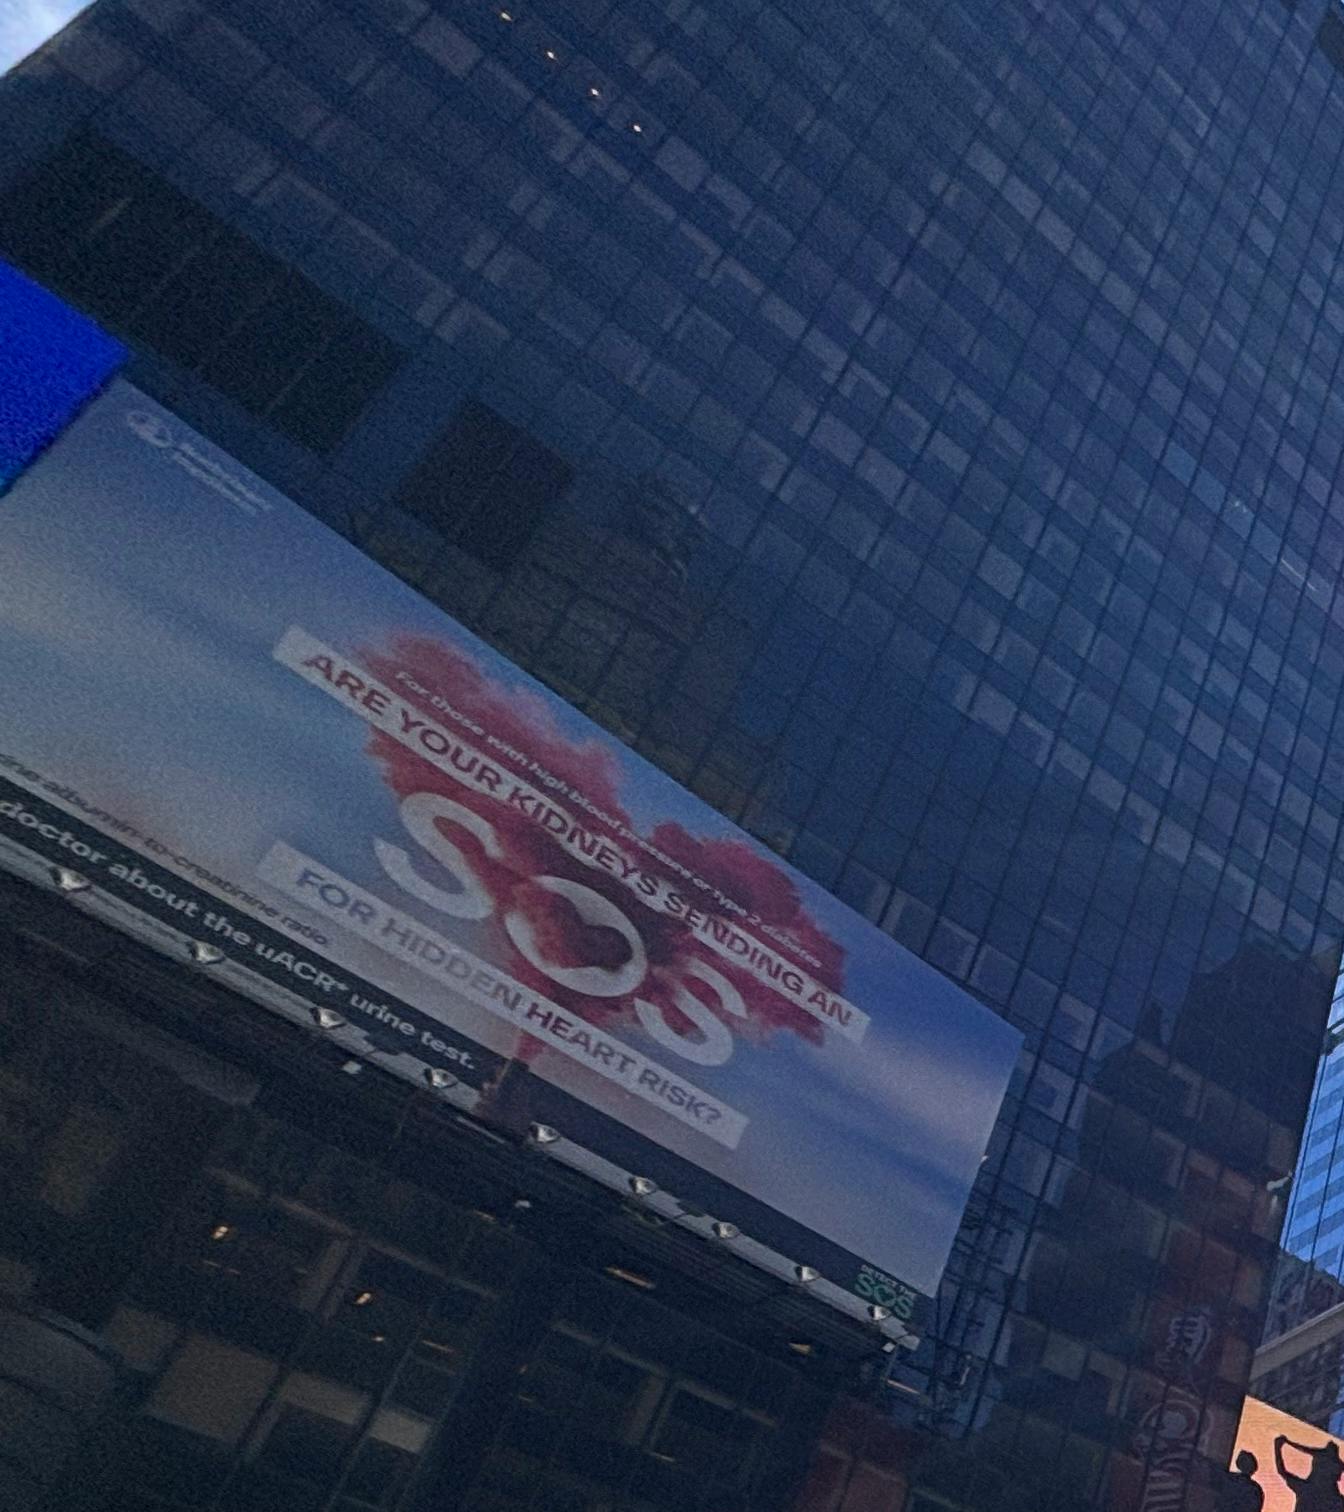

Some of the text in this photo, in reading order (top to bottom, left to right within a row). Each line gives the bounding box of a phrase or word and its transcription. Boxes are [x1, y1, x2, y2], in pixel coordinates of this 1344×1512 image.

[0, 802, 107, 864] doctor
[108, 862, 198, 918] about
[203, 909, 251, 947] the
[350, 993, 415, 1039] urine
[420, 1032, 476, 1072] test.
[302, 655, 853, 1027] ARE YOUR KIDNEYS SENDING AN
[372, 791, 750, 1067] SOS
[396, 671, 429, 696] For
[432, 694, 484, 738] those
[487, 734, 528, 766] with
[569, 789, 618, 828] blood
[761, 922, 823, 969] diabetes
[298, 869, 723, 1125] FOR HIDDEN HEART RISK?
